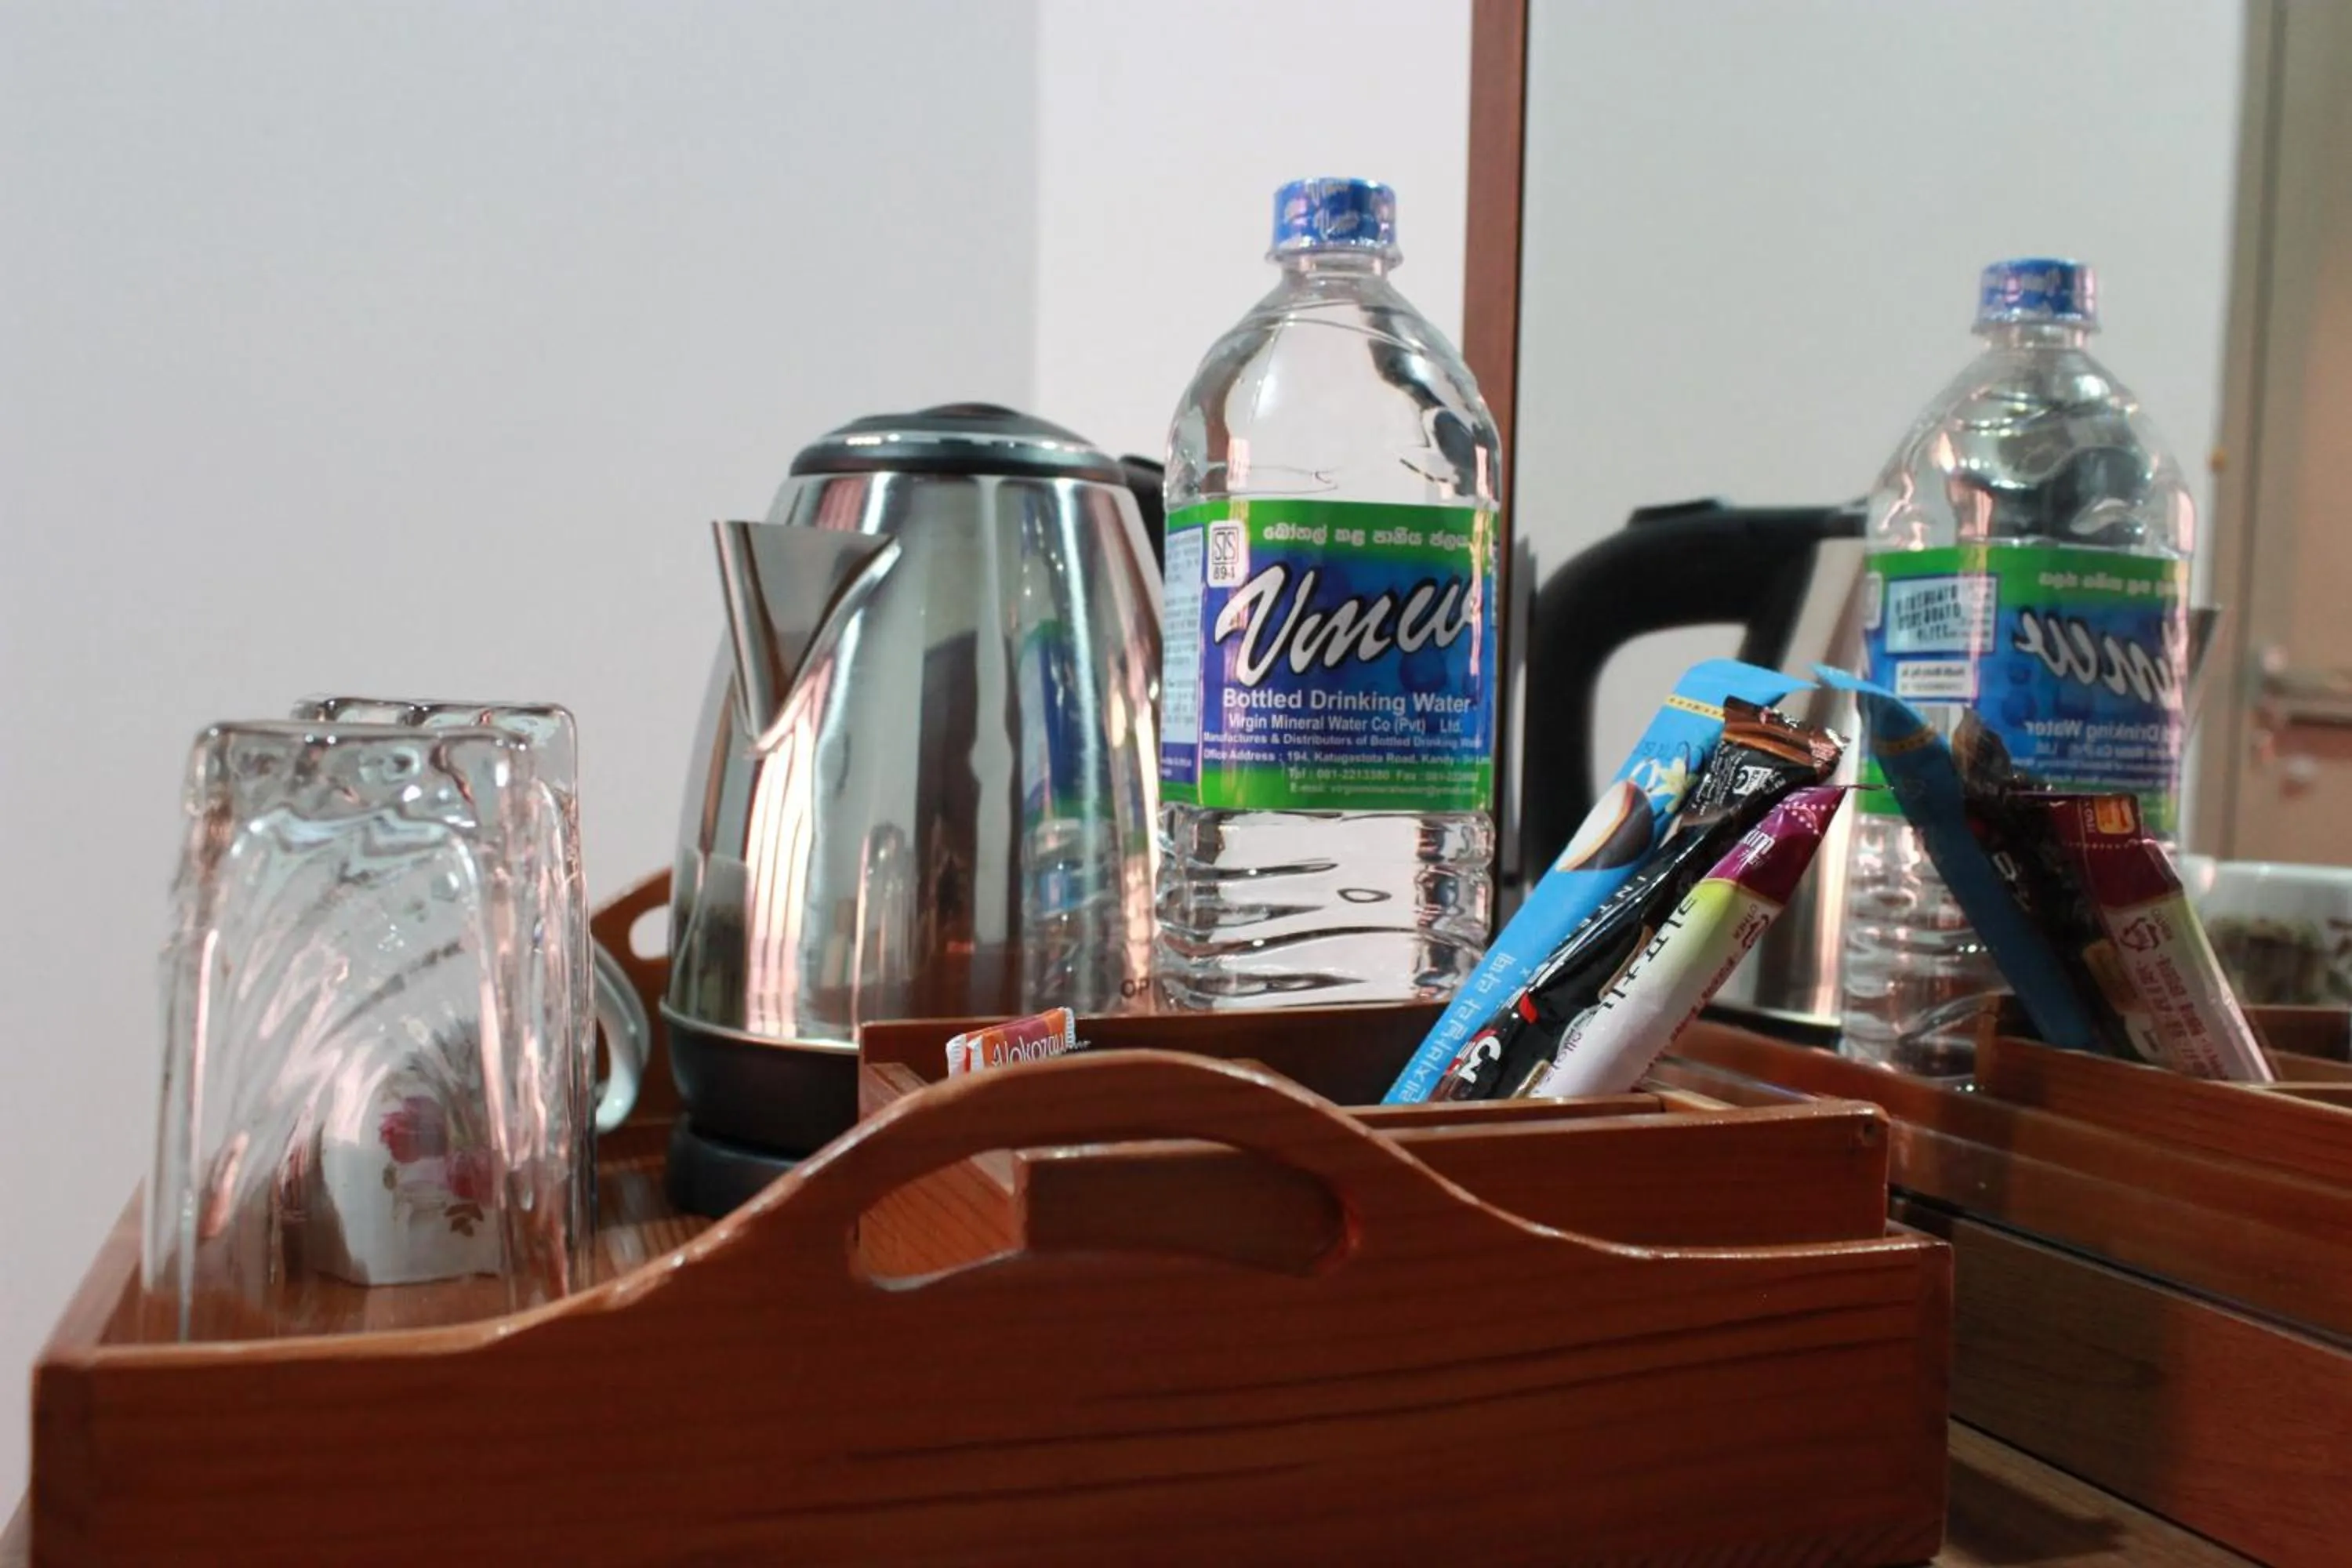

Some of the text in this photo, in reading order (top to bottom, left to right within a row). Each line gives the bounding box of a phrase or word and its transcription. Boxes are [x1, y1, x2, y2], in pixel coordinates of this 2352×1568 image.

[1223, 688, 1471, 716] Bottled Drinking Water
[1229, 713, 1267, 732] Virgin
[1271, 714, 1324, 730] Mineral
[1328, 715, 1367, 731] Water
[1394, 717, 1427, 735] (Pvt)
[1283, 734, 1352, 746] Distributors
[1399, 998, 1482, 1103] 렌치바닐라
